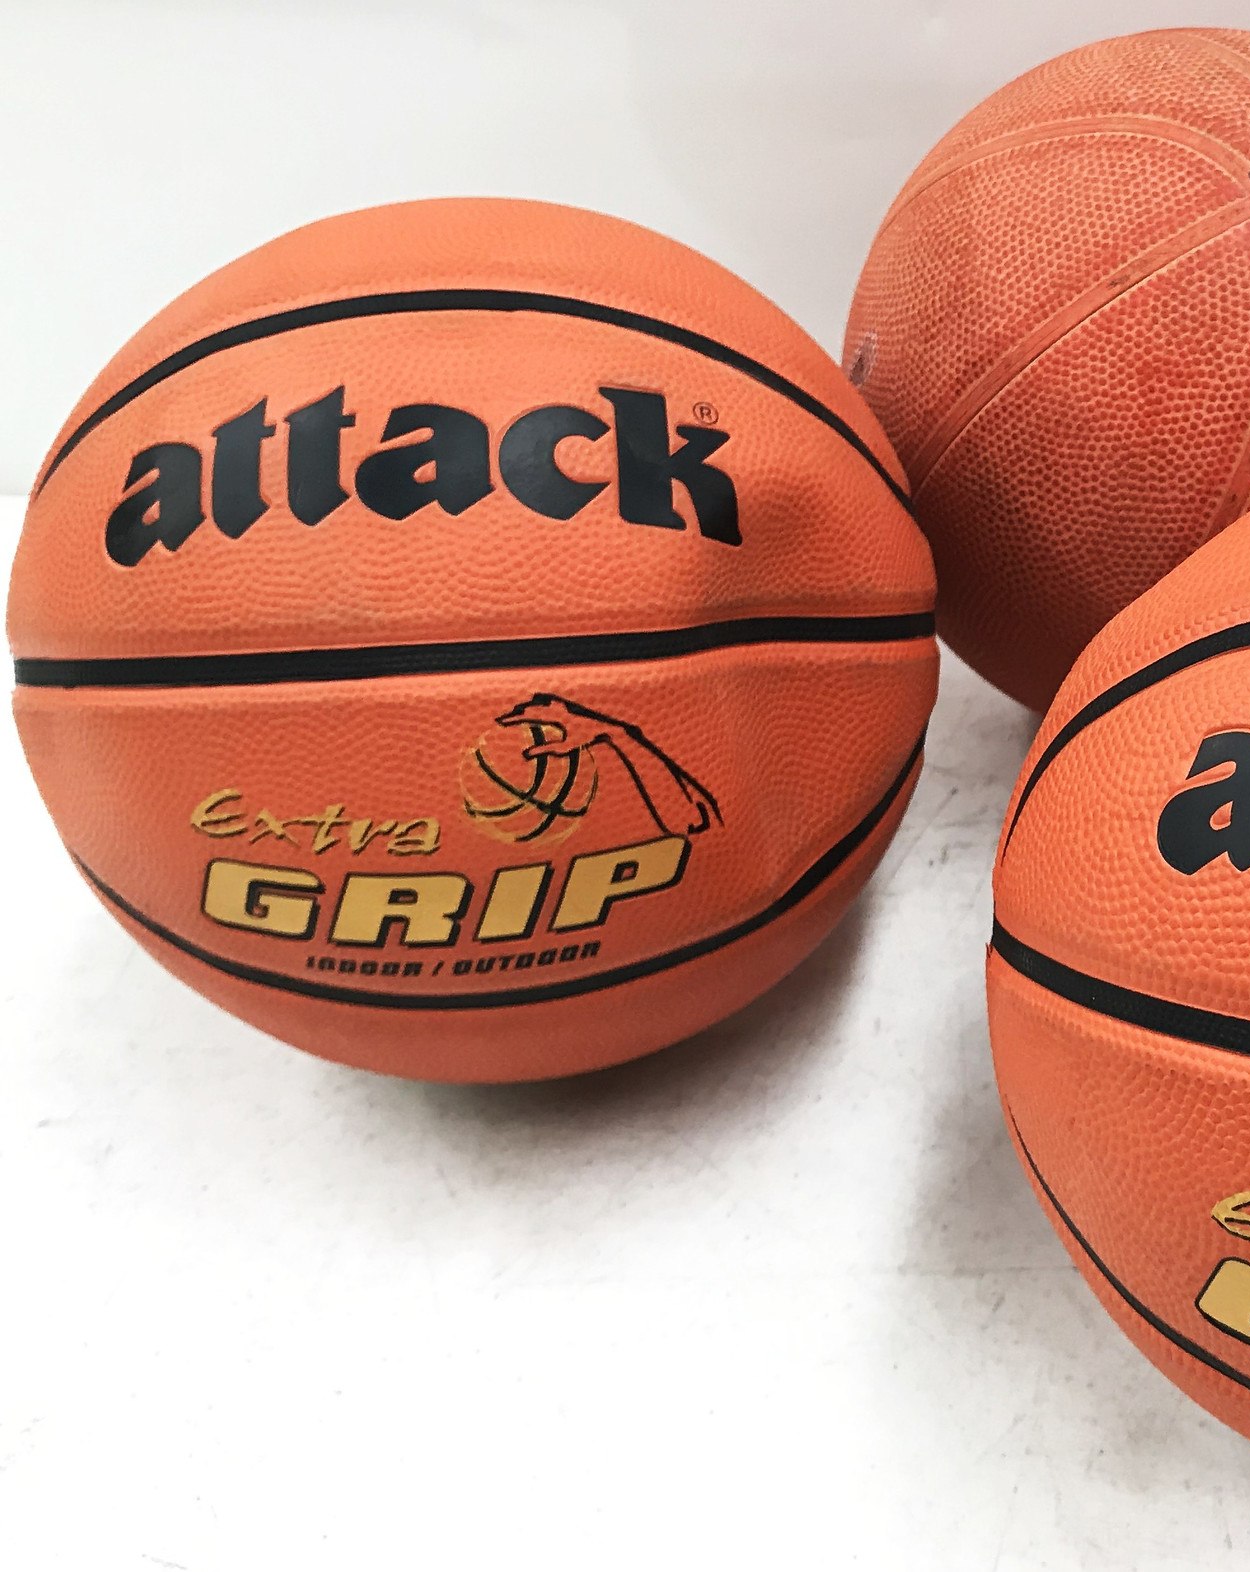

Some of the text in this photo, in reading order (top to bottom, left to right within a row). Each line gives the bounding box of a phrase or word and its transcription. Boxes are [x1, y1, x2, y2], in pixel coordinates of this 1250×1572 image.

[104, 384, 743, 567] attack
[190, 788, 443, 857] Extra
[200, 835, 693, 948] GRIP
[306, 956, 423, 976] INDOOR
[453, 941, 601, 977] OUTDOOR
